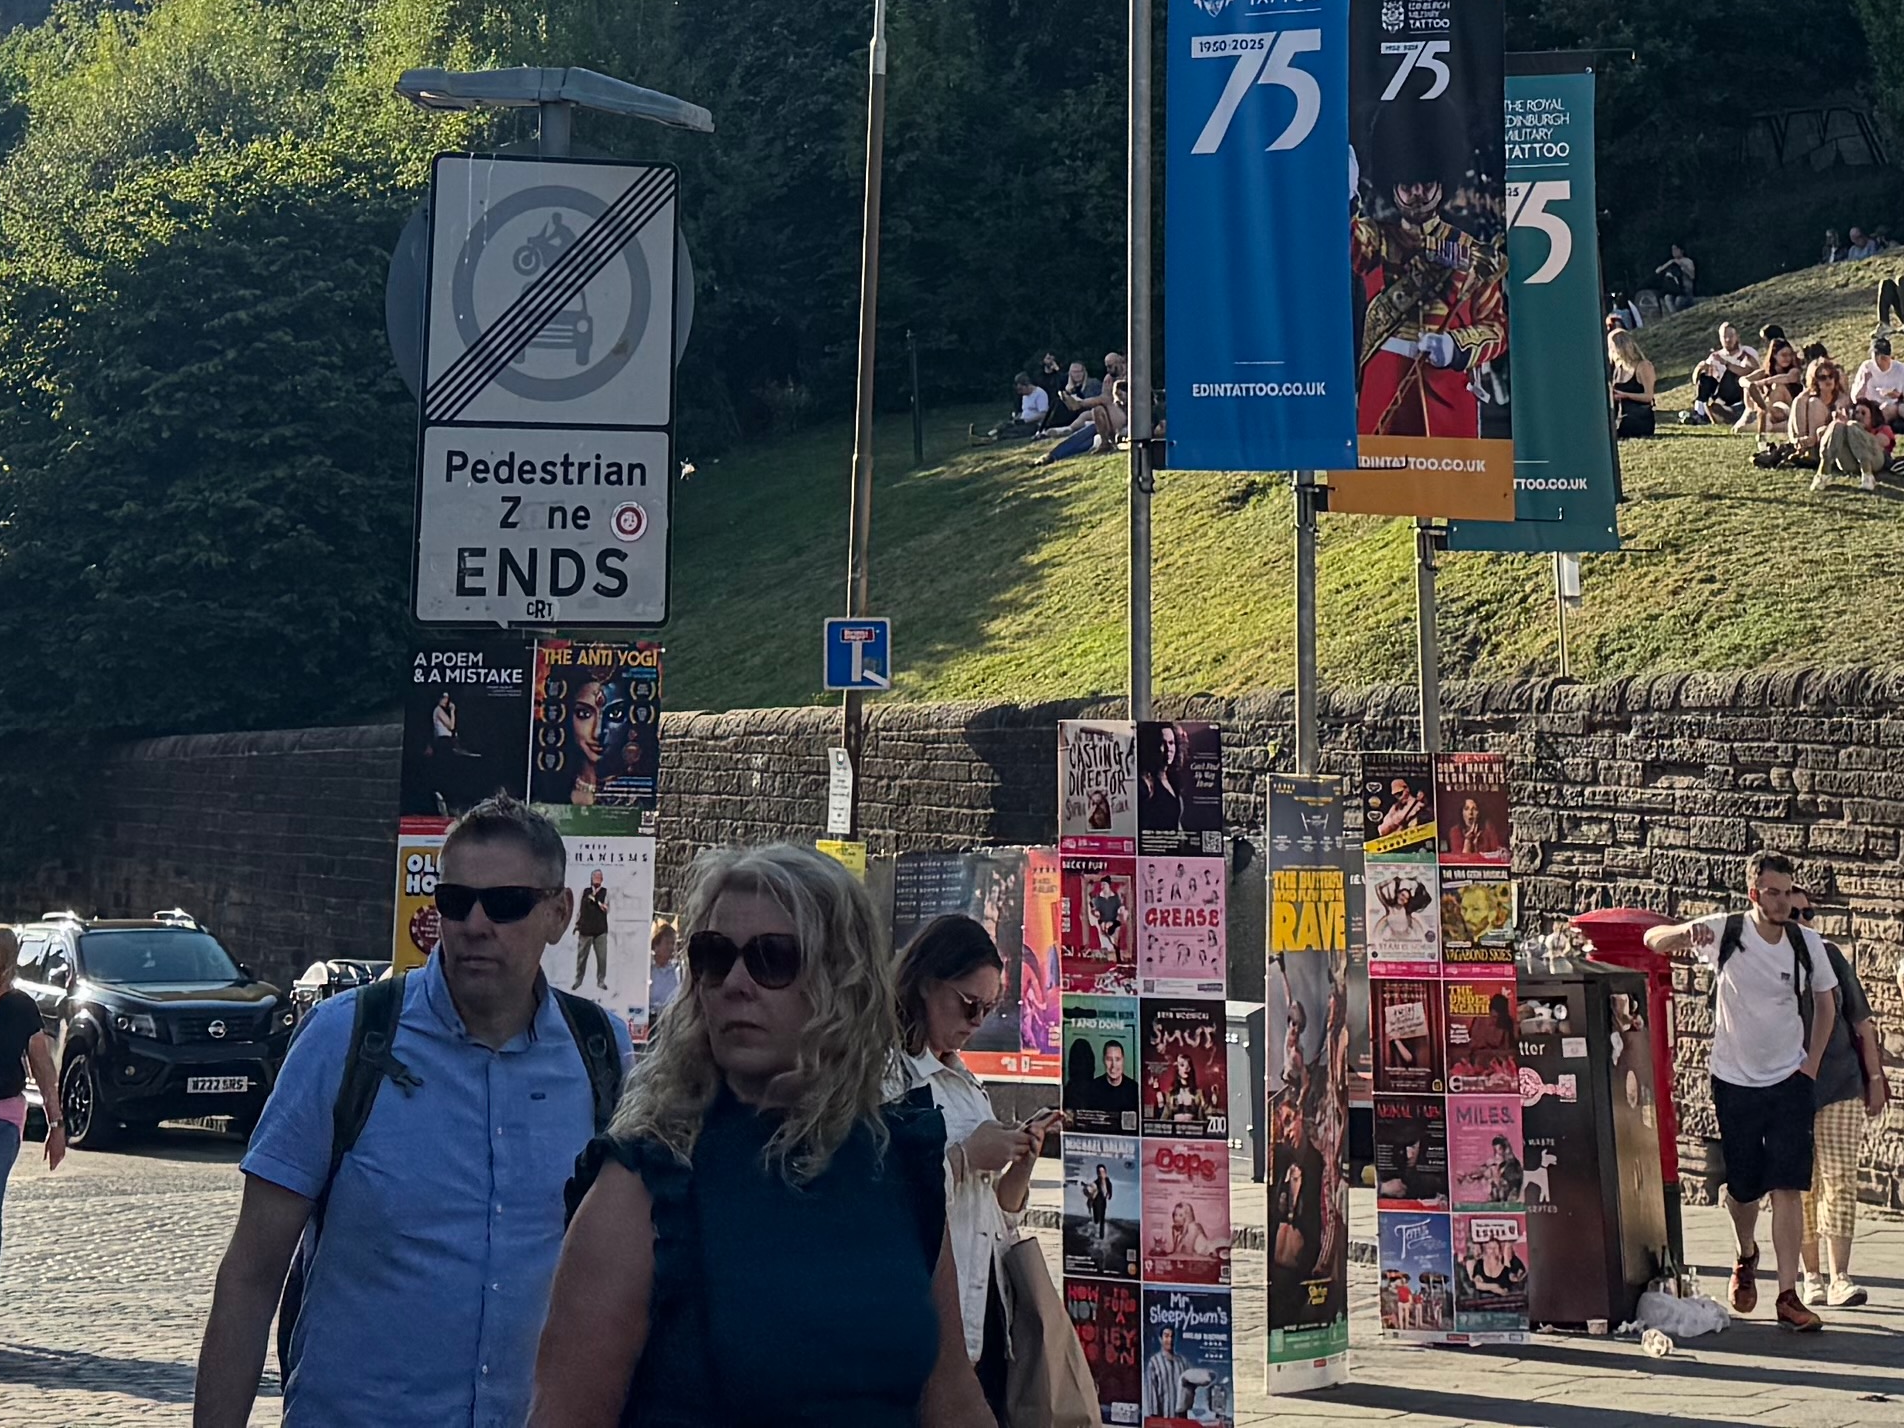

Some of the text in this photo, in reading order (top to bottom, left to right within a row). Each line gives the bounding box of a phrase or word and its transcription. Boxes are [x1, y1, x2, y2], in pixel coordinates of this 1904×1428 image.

[1409, 18, 1450, 29] TATTOO
[1380, 40, 1451, 101] 75
[1191, 28, 1322, 156] 75
[1527, 98, 1565, 111] ROYAL
[1505, 113, 1570, 128] DINBURGH
[1192, 381, 1326, 398] EDINTATTOO.CO.UK
[445, 449, 647, 487] Pedestrian
[1513, 478, 1588, 490] TTOO.CO.UK
[499, 496, 591, 531] Zne
[456, 547, 629, 599] ENDS
[413, 652, 484, 667] A POEM
[545, 648, 659, 667] THE ANTI YOGI
[413, 668, 524, 683] & A MISTAKE
[1069, 740, 1123, 770] CASTING
[1068, 768, 1127, 797] DIRECTOR
[406, 854, 440, 873] OL
[1272, 871, 1297, 889] THE
[1145, 907, 1221, 928] GREASE
[1156, 1148, 1217, 1182] Oops
[1170, 1293, 1190, 1308] Mr
[1149, 1304, 1228, 1331] Sleepybum's
